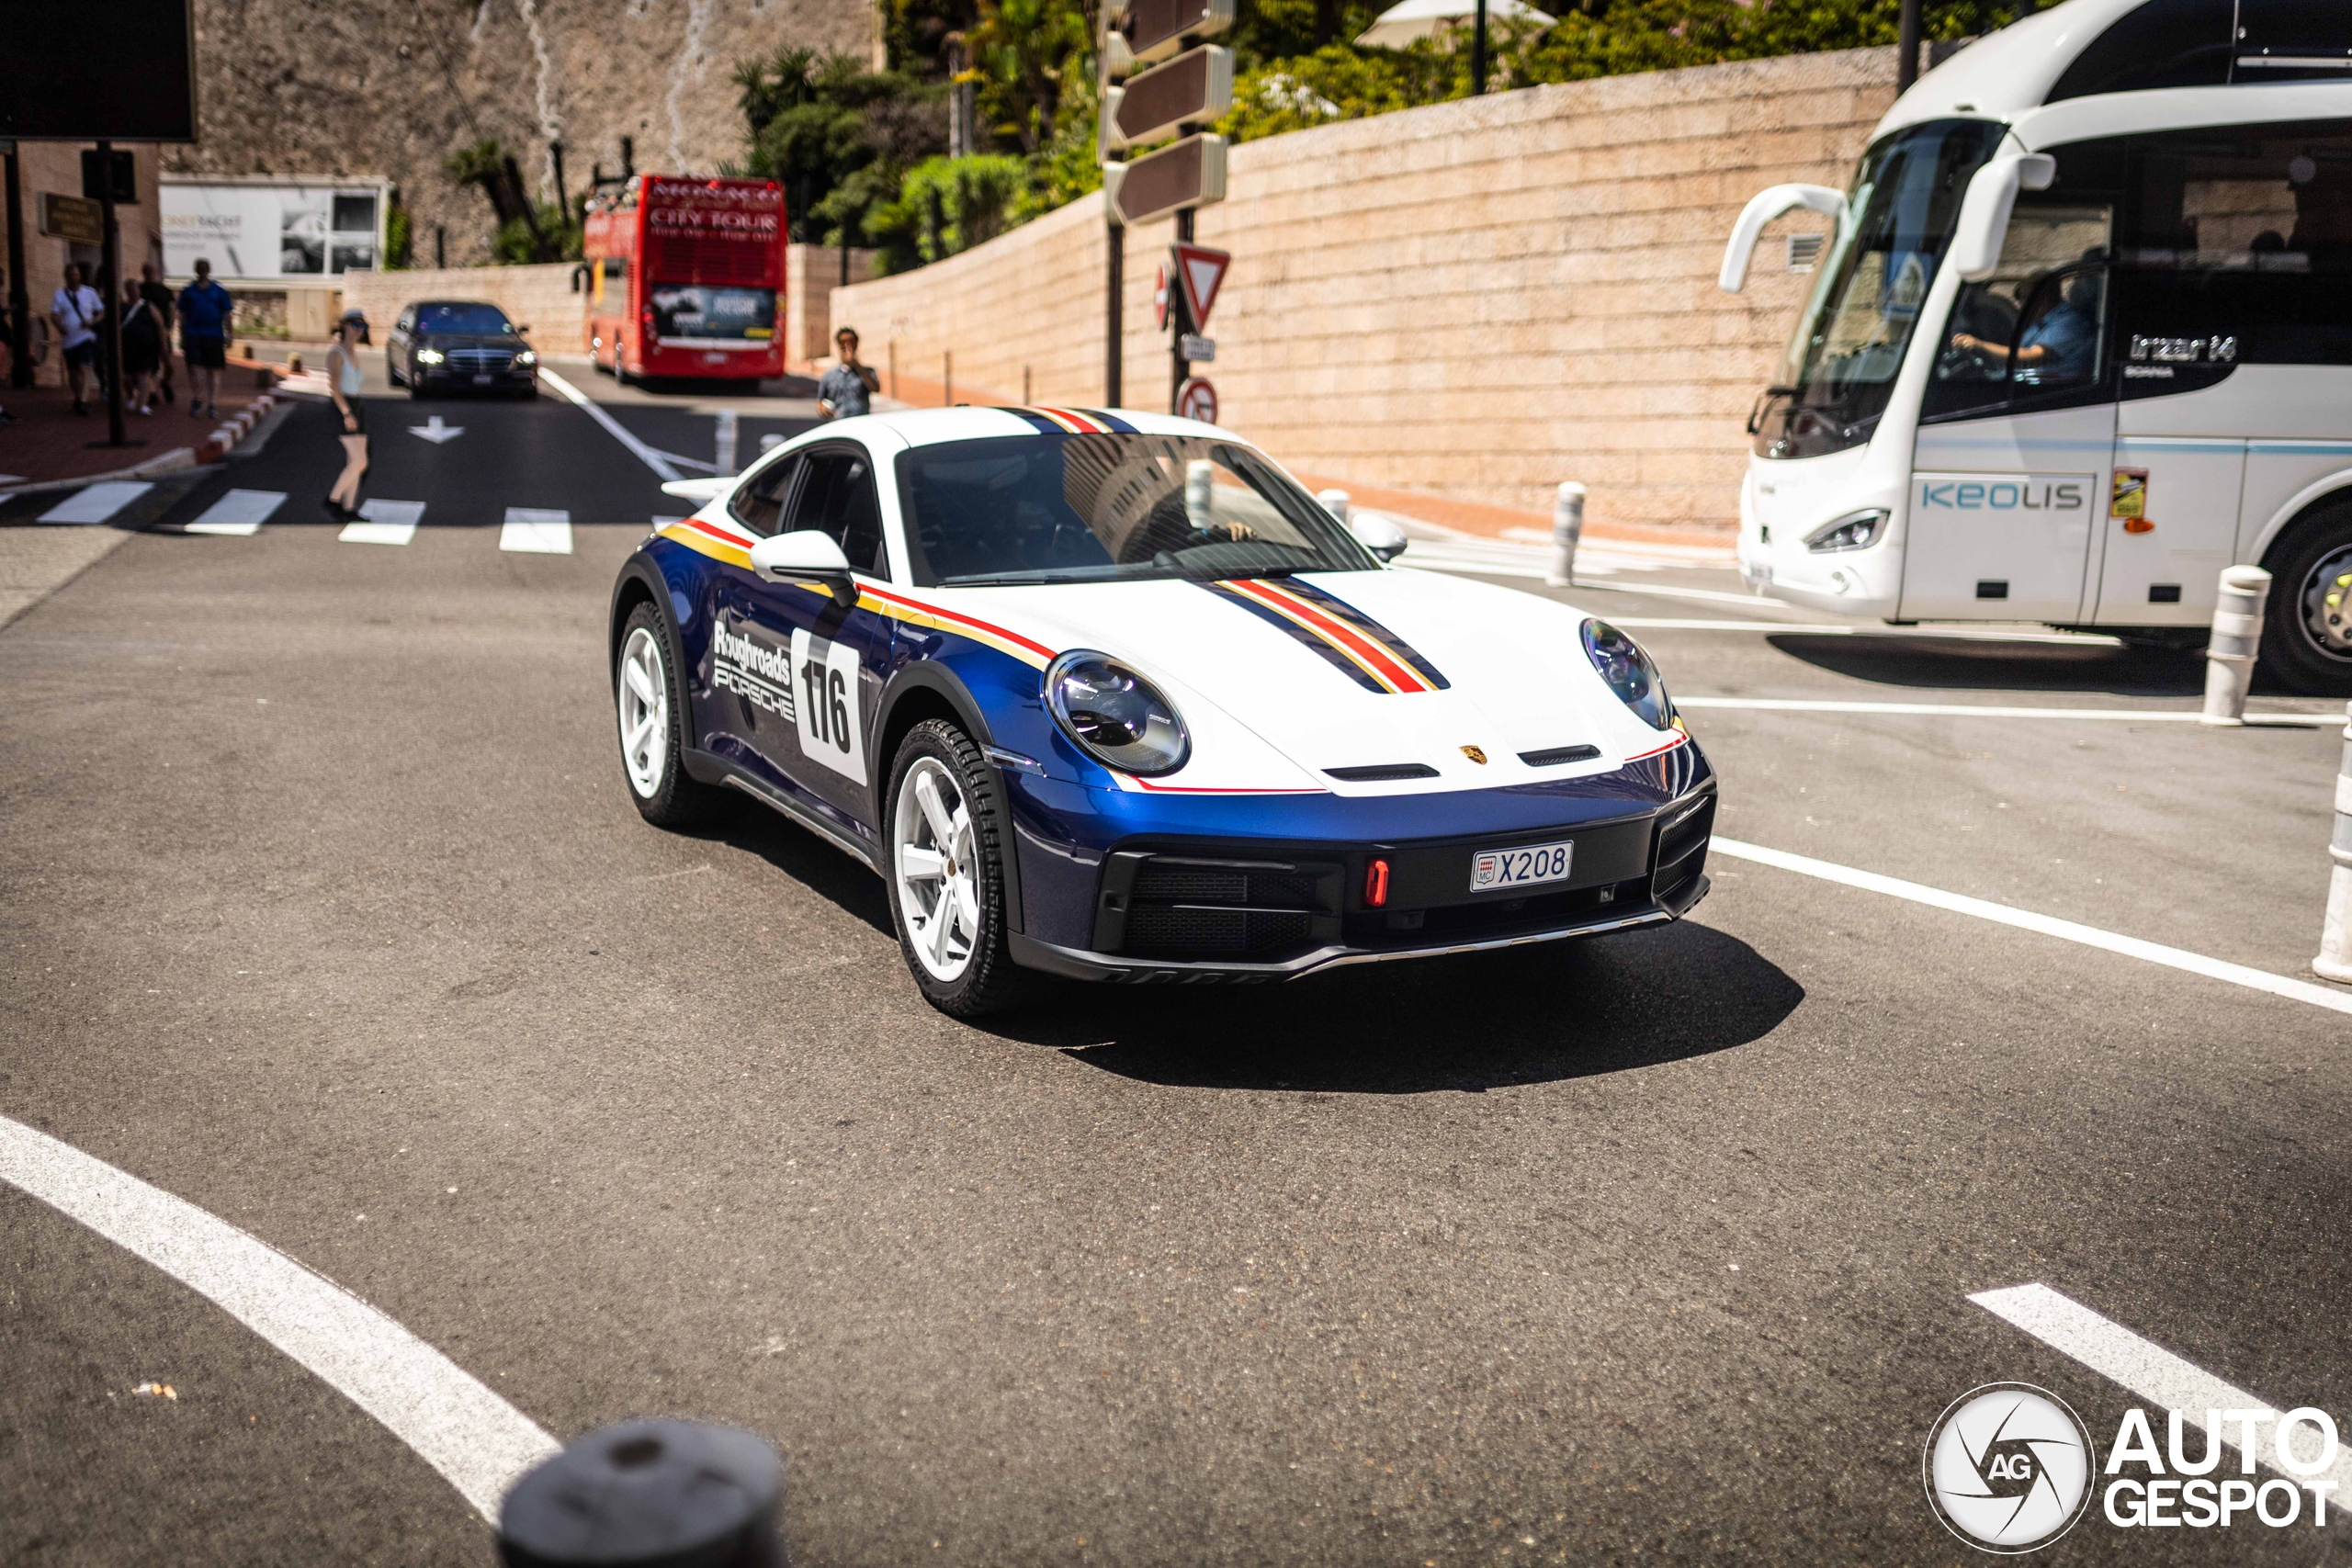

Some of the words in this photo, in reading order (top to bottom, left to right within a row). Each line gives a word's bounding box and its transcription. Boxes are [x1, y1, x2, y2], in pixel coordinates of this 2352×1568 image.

[652, 184, 781, 201] MONACO
[650, 208, 705, 228] CITY
[709, 210, 778, 231] TOUR
[714, 620, 790, 686] Roughroads
[714, 667, 796, 723] PORSCHE
[801, 659, 851, 754] 176
[1478, 871, 1491, 880] MC
[1498, 847, 1566, 883] X208
